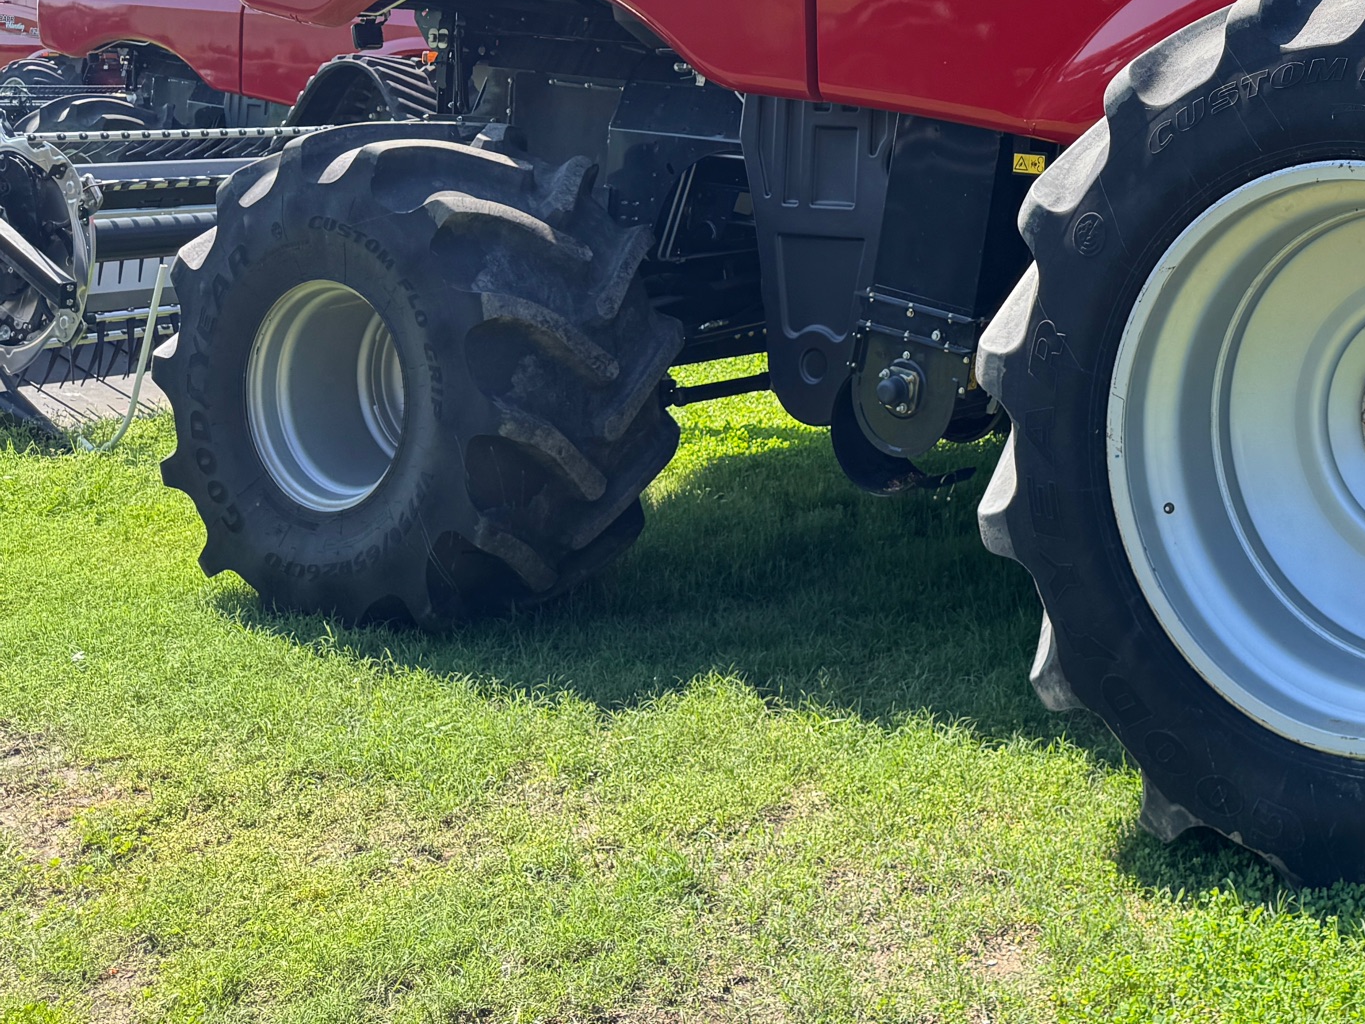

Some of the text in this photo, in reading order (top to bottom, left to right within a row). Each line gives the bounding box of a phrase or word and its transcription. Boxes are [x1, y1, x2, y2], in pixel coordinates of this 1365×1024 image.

[1147, 57, 1350, 156] CUSTOM
[187, 243, 252, 534] GOODYEAR
[307, 214, 444, 419] CUSTOM FLO GRIP
